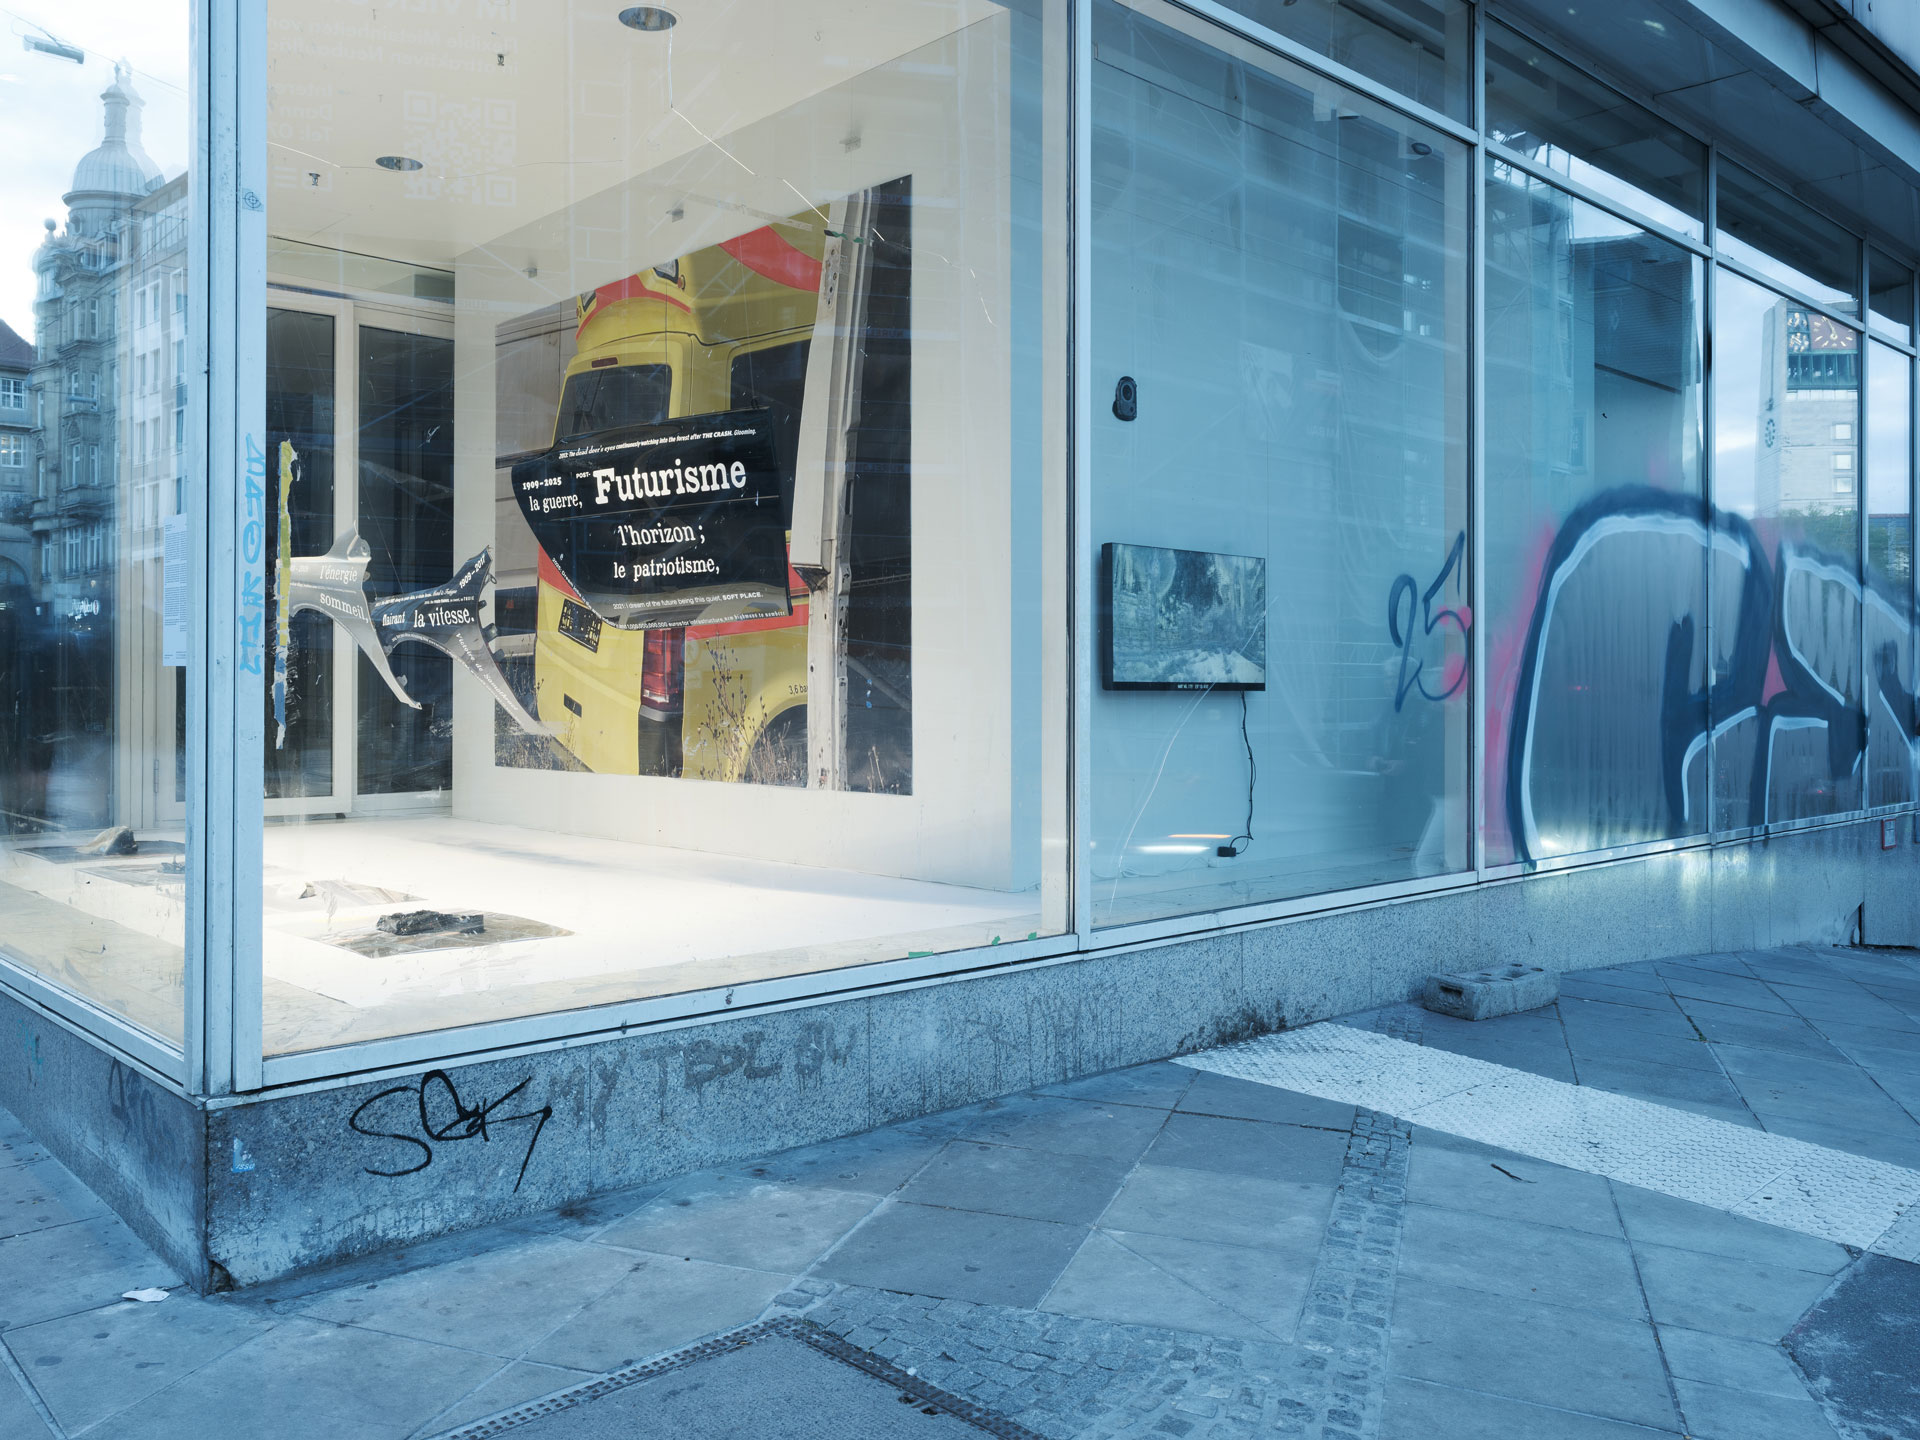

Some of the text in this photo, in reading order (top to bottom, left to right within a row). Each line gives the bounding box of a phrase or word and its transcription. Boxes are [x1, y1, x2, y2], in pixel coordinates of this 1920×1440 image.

[575, 446, 589, 456] dead
[604, 445, 616, 453] eyes
[575, 471, 591, 479] POST-
[593, 458, 748, 505] Futurisme
[529, 494, 583, 514] la guerre,
[319, 564, 358, 585] l'énergie
[613, 556, 720, 582] le patriotisme,
[320, 592, 369, 623] sommeil,
[413, 607, 475, 628] la vitesse.
[382, 611, 405, 627] flairant
